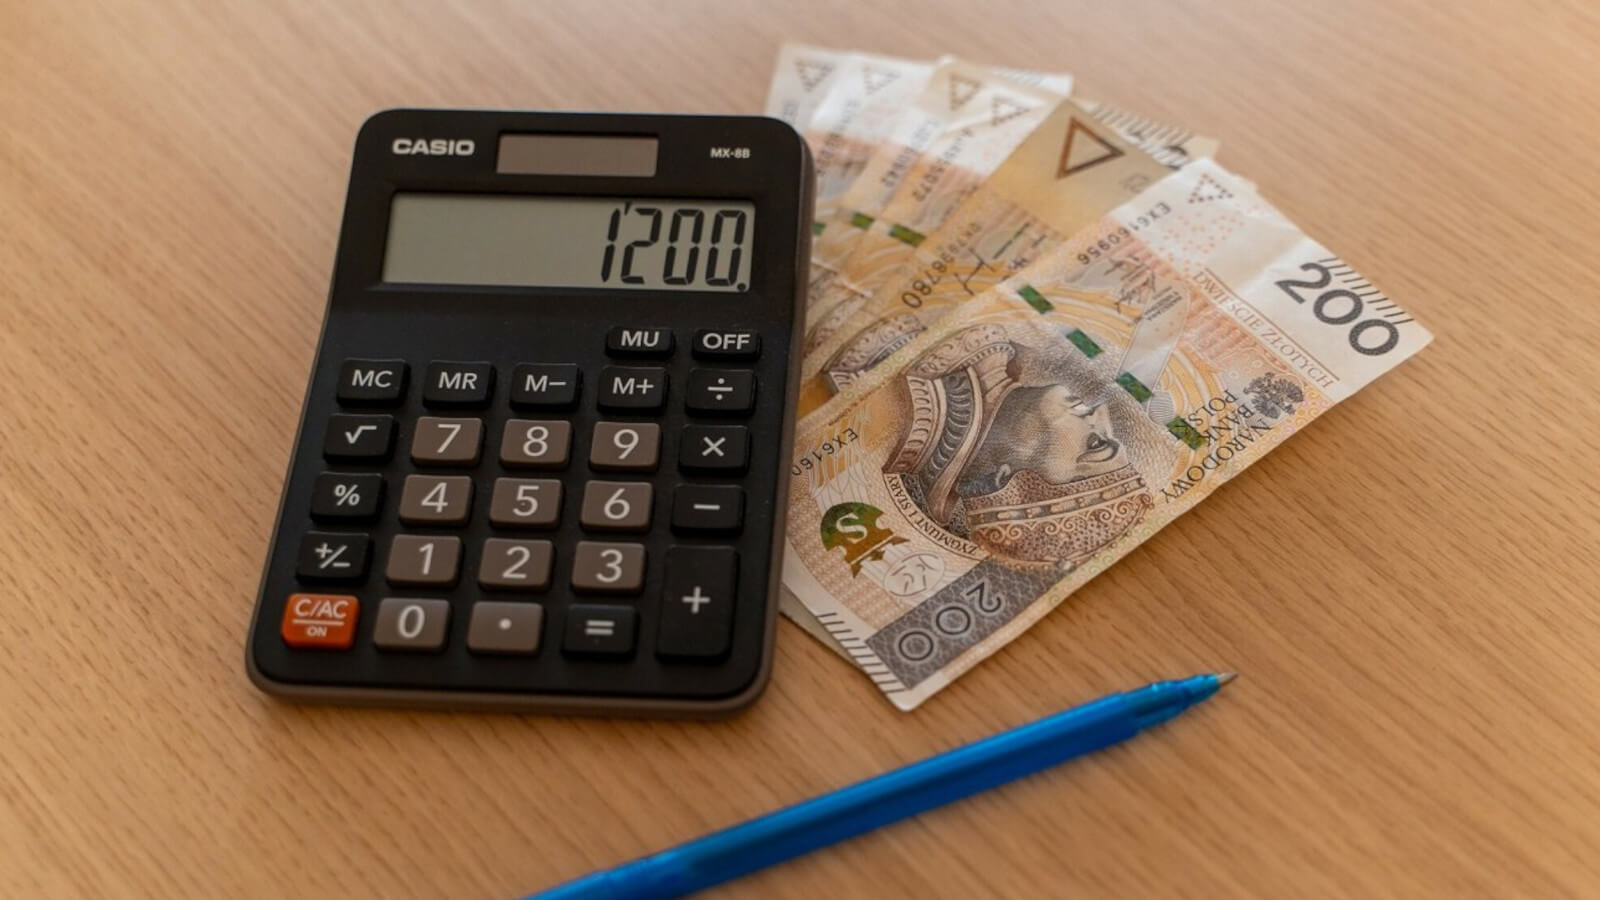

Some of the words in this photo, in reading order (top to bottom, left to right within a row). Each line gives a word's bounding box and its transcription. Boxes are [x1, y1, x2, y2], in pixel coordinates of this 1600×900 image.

[392, 138, 476, 156] CASIO
[710, 147, 751, 159] MX-8B
[1275, 262, 1399, 356] 200
[621, 330, 660, 347] MU
[702, 332, 751, 350] OFF
[351, 369, 393, 388] MC
[438, 371, 478, 390] MR
[612, 376, 655, 395] M+
[437, 423, 461, 453] 7
[1199, 404, 1254, 446] BANK
[523, 426, 549, 457] 8
[613, 428, 639, 460] 9
[1161, 419, 1272, 503] NARODOWY
[334, 484, 360, 506] %
[421, 482, 448, 513] 4
[513, 485, 540, 517] 5
[604, 488, 630, 520] 6
[887, 475, 911, 510] STARY
[836, 513, 868, 543] S
[916, 518, 978, 555] ZYGMUNT
[419, 543, 434, 575] 1
[502, 546, 530, 579] 2
[596, 549, 623, 583] 3
[295, 598, 349, 619] C/AC
[398, 604, 425, 638] 0
[898, 582, 1001, 662] 200
[306, 625, 328, 637] ON
